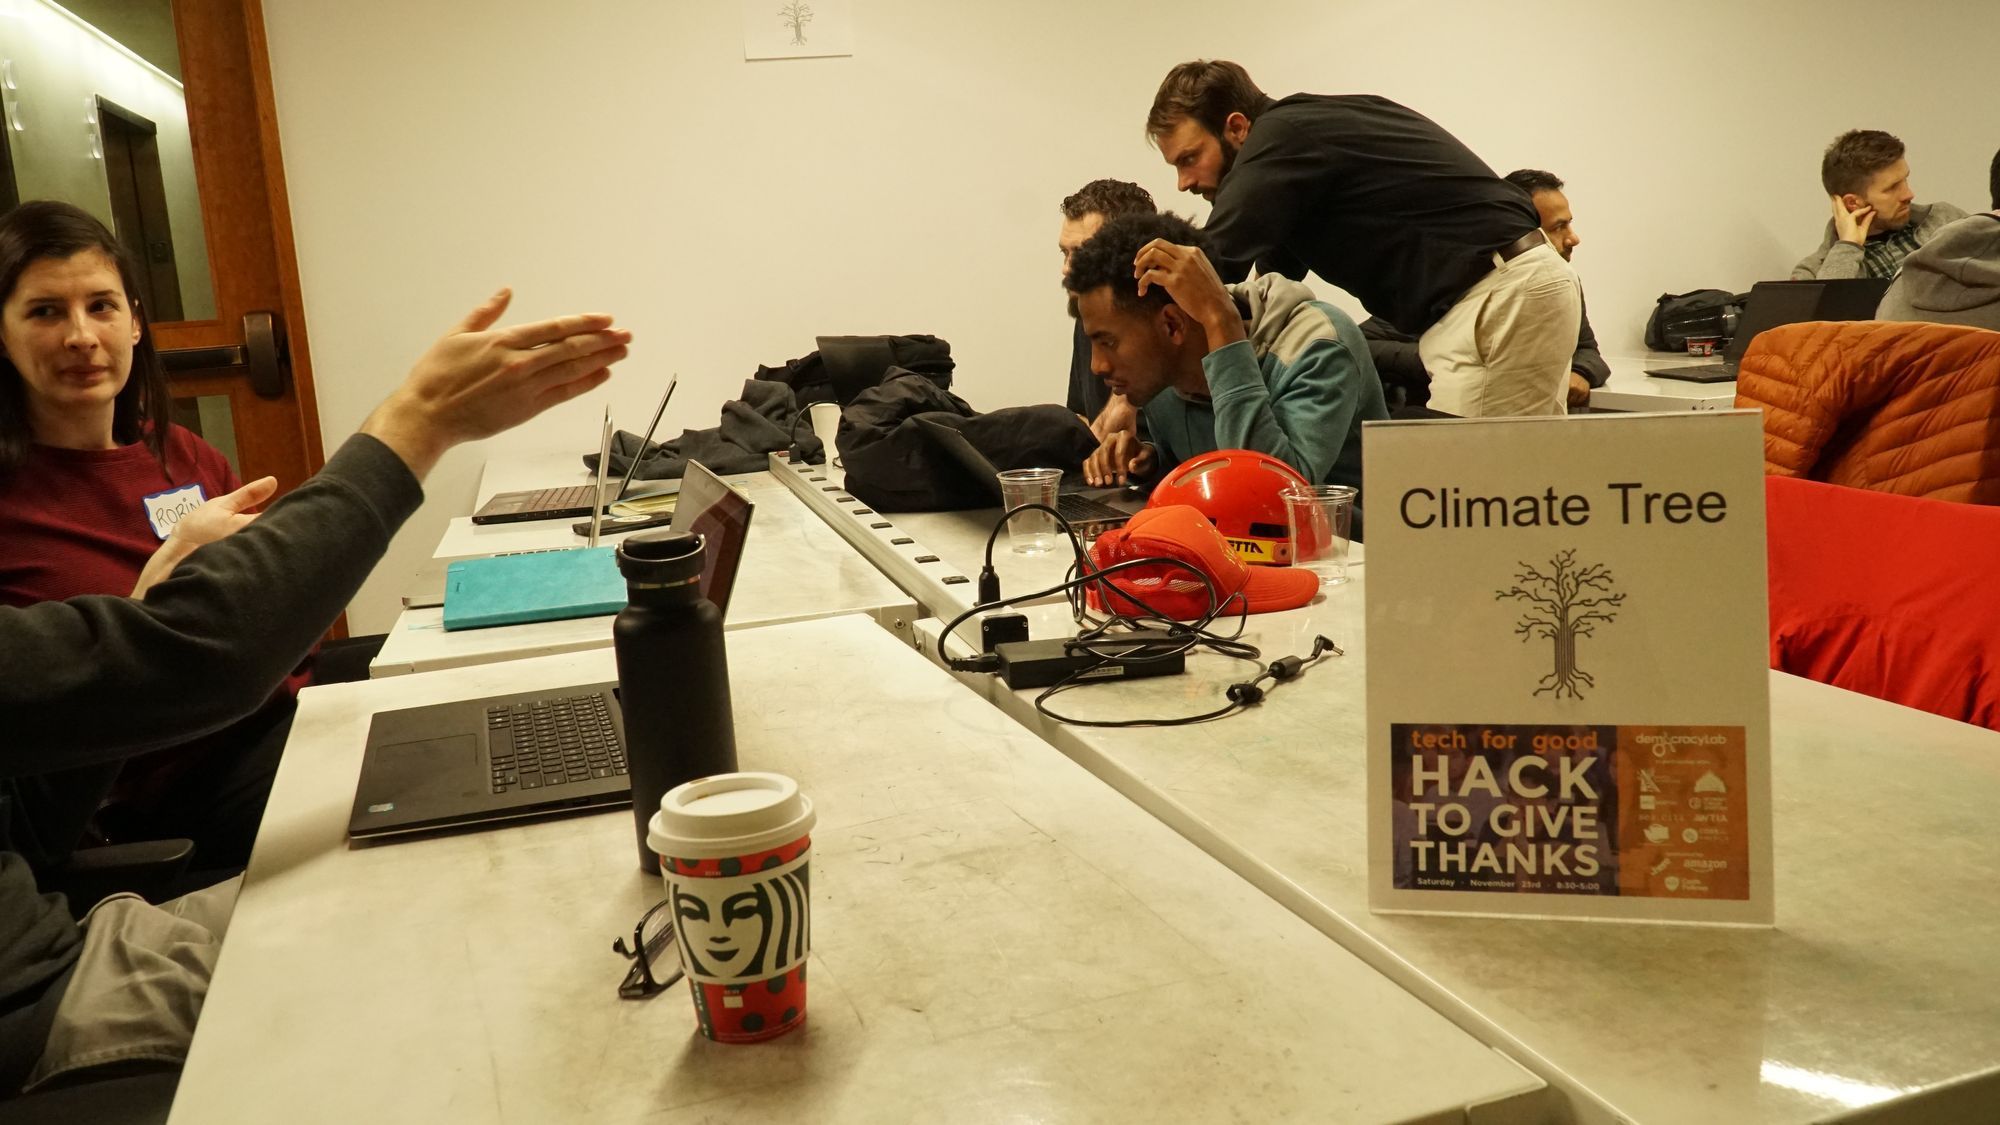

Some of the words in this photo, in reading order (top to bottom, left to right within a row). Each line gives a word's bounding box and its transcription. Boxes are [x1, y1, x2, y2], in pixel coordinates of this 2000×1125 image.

[1400, 486, 1590, 529] Climate
[1607, 482, 1728, 524] Tree
[1411, 730, 1466, 749] tech
[1481, 730, 1517, 749] for
[1532, 731, 1598, 754] good
[1412, 754, 1599, 800] HACK
[1409, 802, 1472, 836] TO
[1489, 803, 1599, 839] GIVE
[1409, 840, 1600, 877] THANKS
[1417, 877, 1455, 888] Saturday
[1470, 878, 1515, 888] November
[1521, 880, 1541, 889] 23rd
